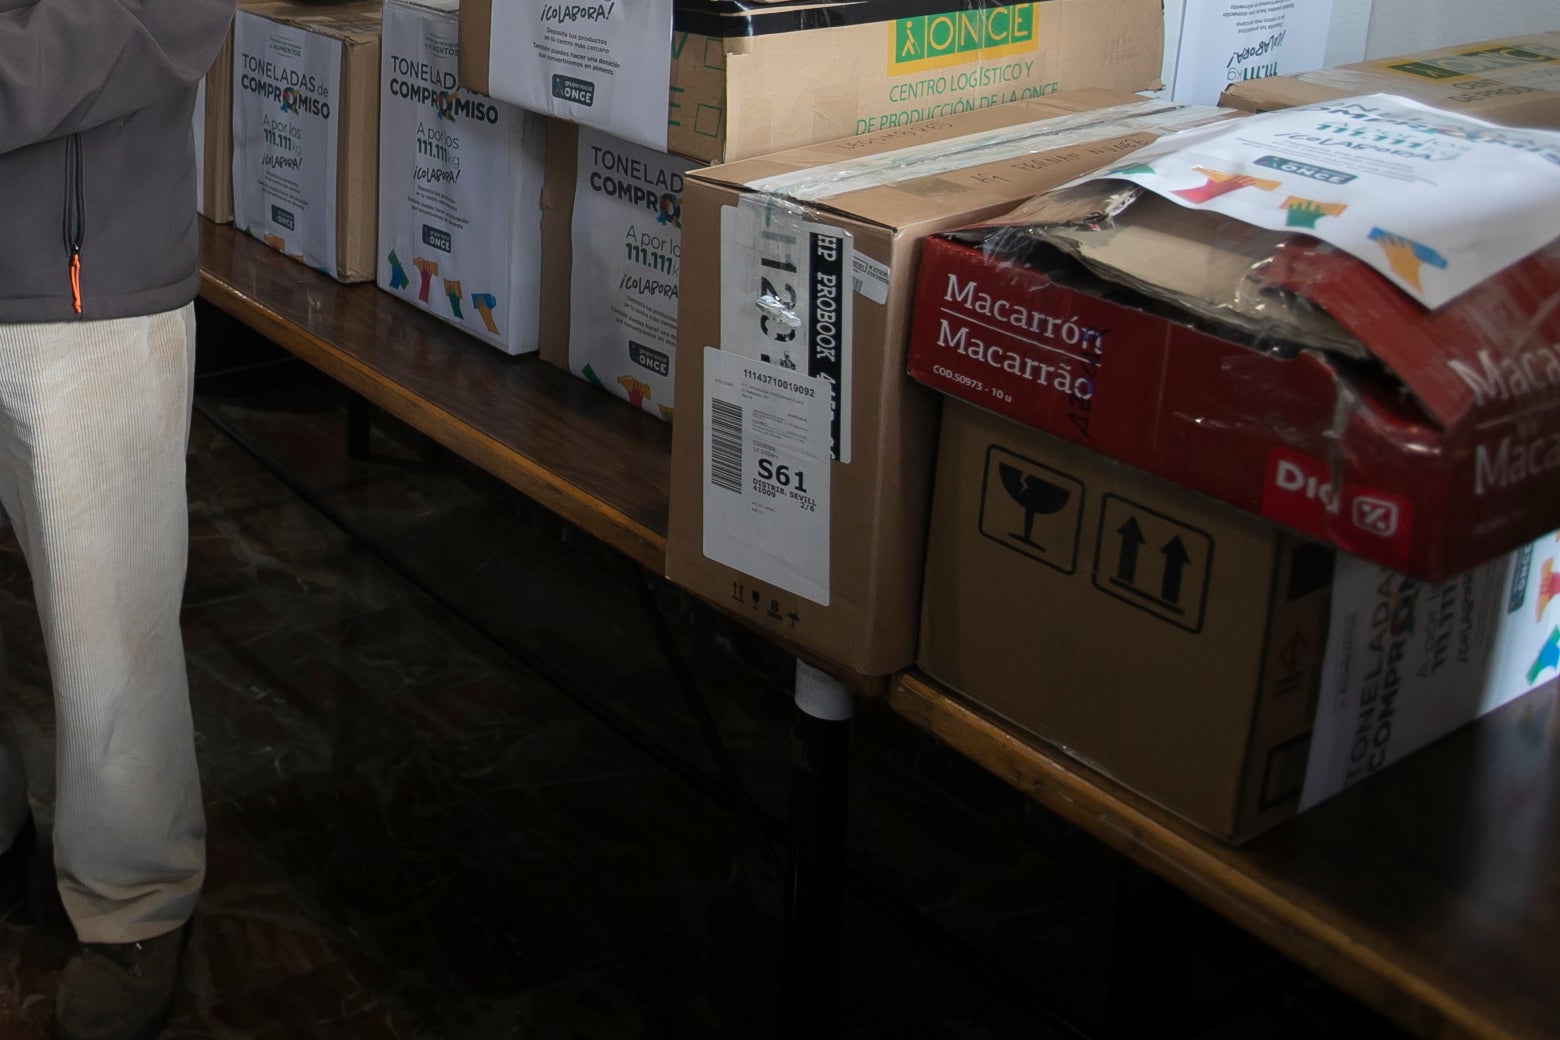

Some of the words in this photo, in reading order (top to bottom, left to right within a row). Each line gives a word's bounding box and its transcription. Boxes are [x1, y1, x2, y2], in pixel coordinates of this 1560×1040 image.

[930, 2, 1029, 50] ONCE
[242, 53, 315, 93] TONELADAS
[317, 83, 328, 97] de
[391, 55, 490, 98] TONELAD
[890, 77, 946, 103] CENTRO
[950, 63, 1022, 92] LOGÍSTICO
[1024, 61, 1034, 78] Y
[242, 74, 330, 119] COMPROMISO
[390, 78, 498, 124] COMPROMISO
[564, 87, 591, 103] ONCE
[263, 113, 269, 125] A
[272, 120, 287, 132] por
[289, 122, 302, 139] los
[417, 122, 425, 136] A
[856, 117, 876, 136] DE
[591, 146, 683, 193] TONELAD
[430, 235, 450, 251] ONCE
[626, 225, 637, 242] A
[641, 232, 666, 251] por
[817, 235, 836, 261] HP
[816, 272, 836, 362] PROBOOK
[943, 273, 1103, 355] Macarrón
[639, 354, 667, 373] ONCE
[937, 318, 1094, 400] Macarrão
[992, 388, 1004, 399] 10
[753, 485, 776, 498] 41009
[758, 458, 807, 493] S61
[753, 478, 787, 496] DISTRIB.
[789, 491, 816, 507] SEVILL
